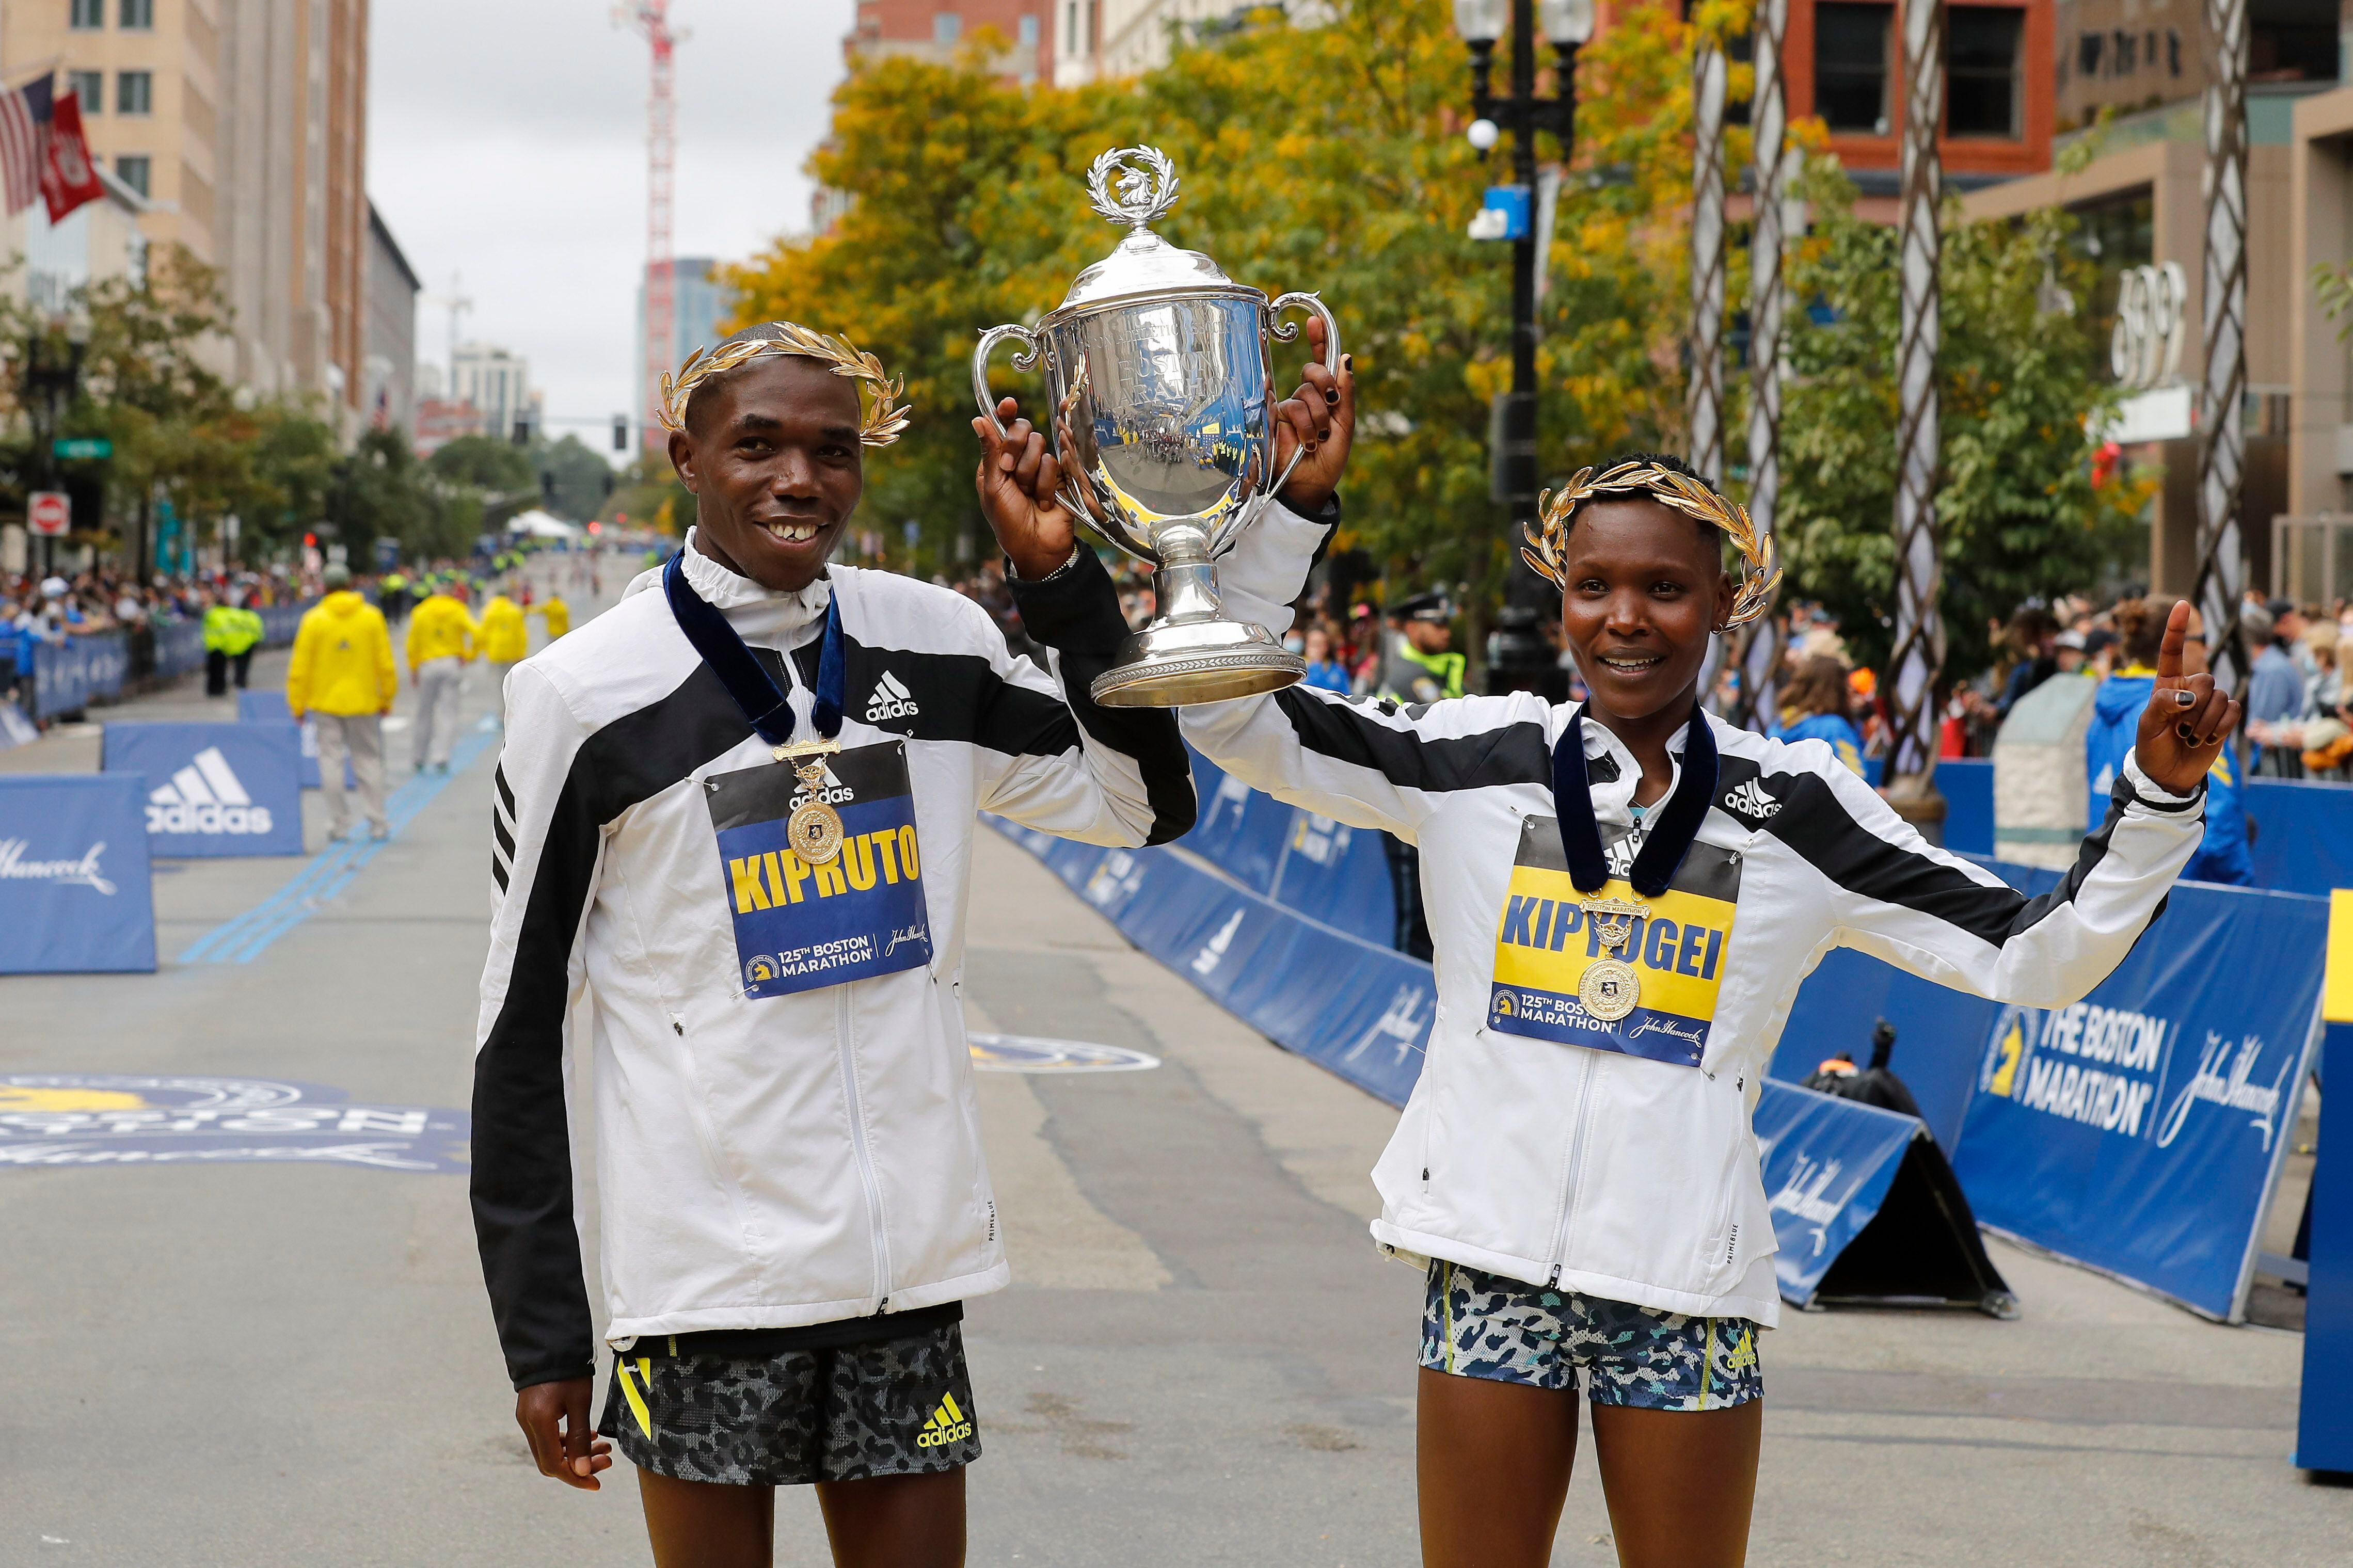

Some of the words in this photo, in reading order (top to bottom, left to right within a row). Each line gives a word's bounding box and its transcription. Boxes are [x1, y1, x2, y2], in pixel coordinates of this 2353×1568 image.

[729, 824, 919, 914] KIPRUTO
[778, 948, 810, 964] 125TH
[813, 935, 869, 957] BOSTON
[1501, 894, 1724, 981] KIPYOGEI
[1521, 994, 1553, 1008] 125TH
[1554, 998, 1590, 1016] BOS
[1629, 1016, 1662, 1038] John
[1660, 1019, 1704, 1048] Hancock
[2079, 1004, 2167, 1073] BOSTON
[1726, 1223, 1739, 1265] PRIMEBLUE
[1727, 1350, 1756, 1369] adidas
[917, 1422, 972, 1448] adidas
